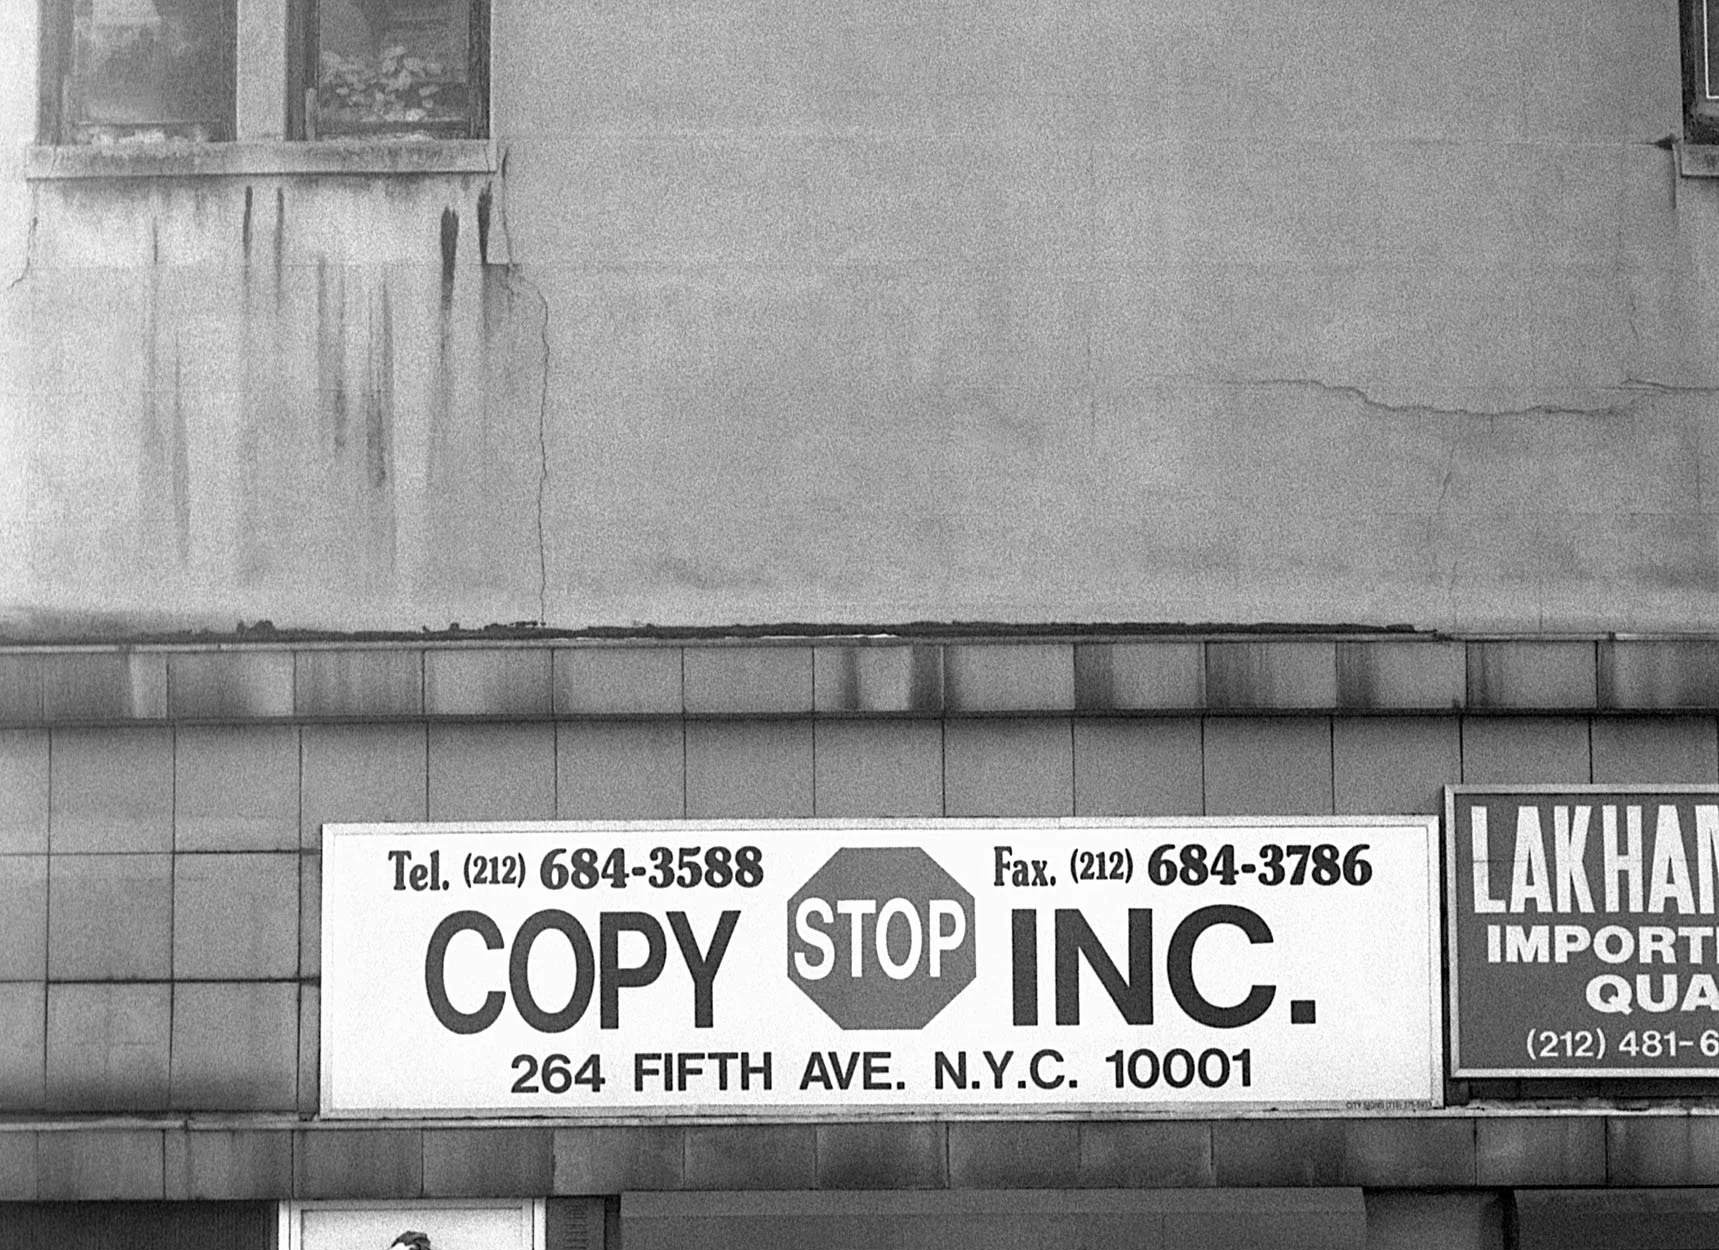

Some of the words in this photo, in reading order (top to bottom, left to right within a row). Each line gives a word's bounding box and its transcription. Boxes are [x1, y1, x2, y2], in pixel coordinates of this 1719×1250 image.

[388, 850, 449, 891] Tel.
[464, 853, 526, 888] (212)
[540, 846, 763, 890] 684-3588
[994, 846, 1056, 887] Fax.
[1071, 848, 1133, 883] (212)
[1148, 844, 1372, 886] 684-3786
[425, 909, 741, 1034] COPY
[794, 897, 966, 980] STOP
[1012, 904, 1316, 1029] INC.
[1488, 925, 1719, 964] IMPORT
[1586, 974, 1719, 1015] QUA
[1527, 1028, 1605, 1059] (212)
[1619, 1030, 1719, 1057] 481-6
[511, 1054, 606, 1094] 264
[635, 1052, 772, 1091] FIFTH
[800, 1052, 905, 1090] AVE.
[935, 1049, 1077, 1089] N.Y.C.
[1106, 1048, 1251, 1089] 10001
